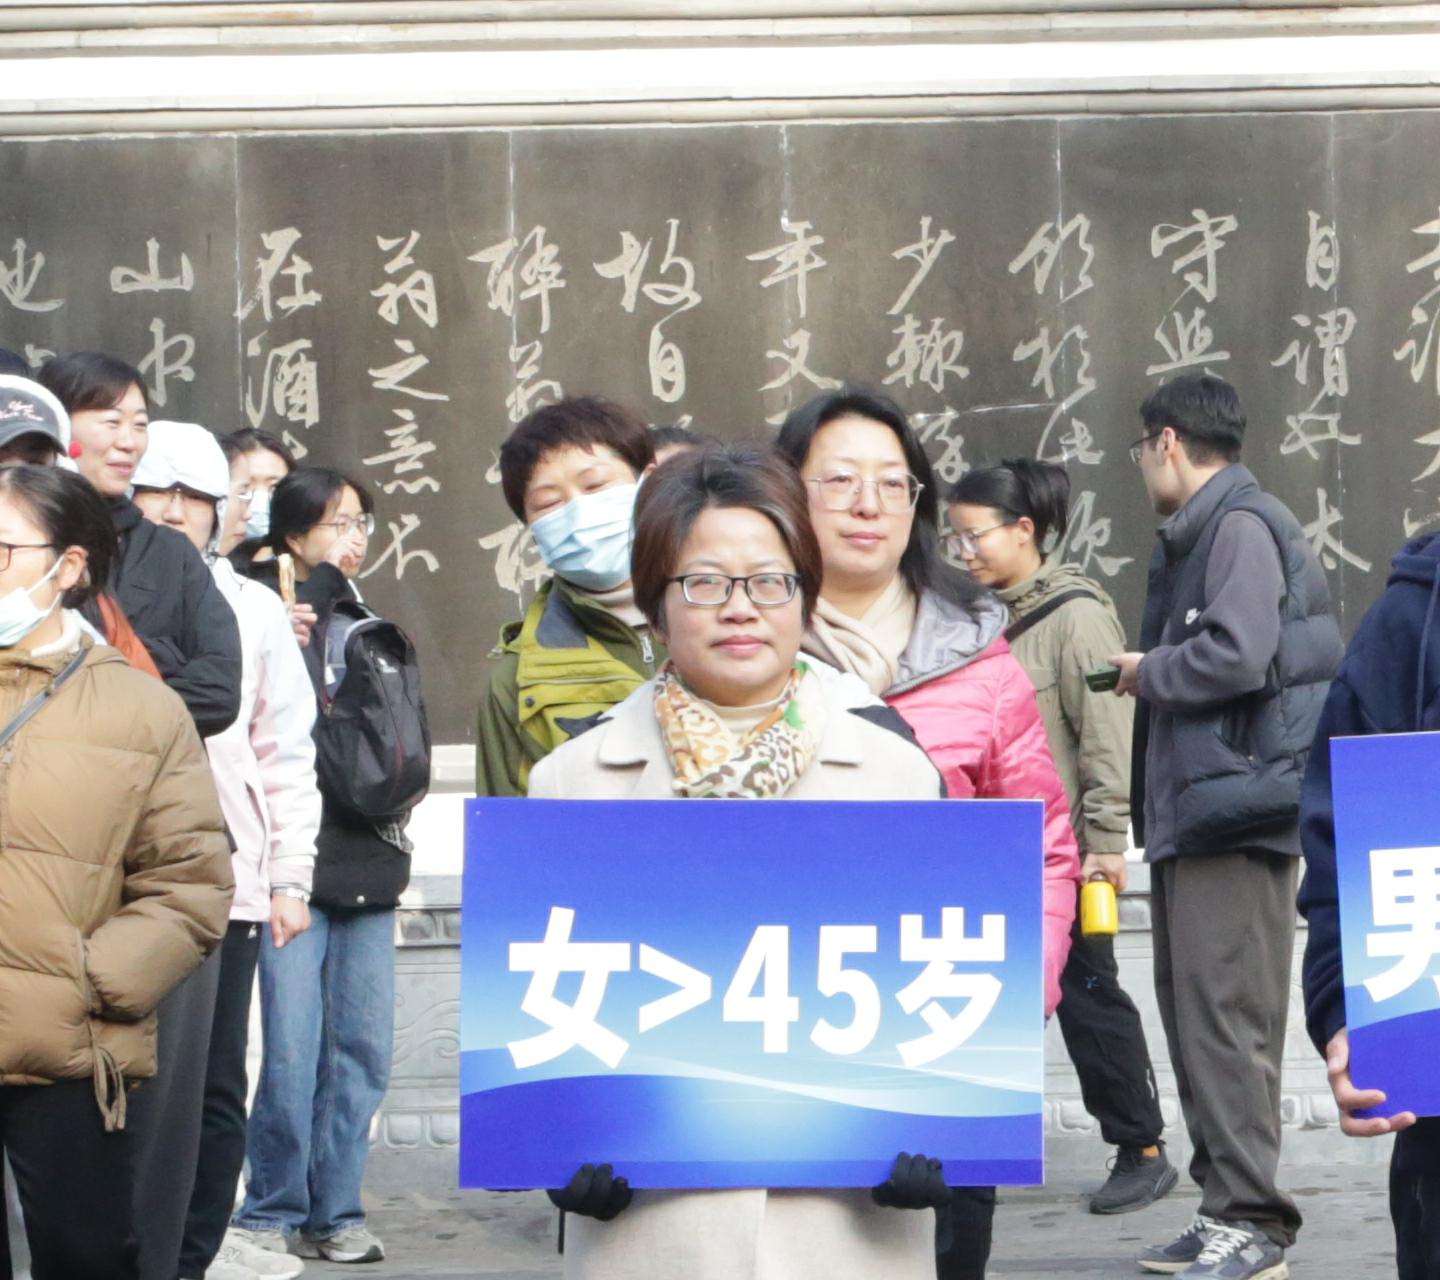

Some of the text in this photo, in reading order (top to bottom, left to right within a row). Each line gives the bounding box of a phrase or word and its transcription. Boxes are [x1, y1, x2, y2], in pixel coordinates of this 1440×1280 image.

[245, 227, 323, 460] 在酒
[593, 219, 703, 428] 故自
[746, 220, 844, 425] 年又
[506, 906, 1006, 1070] 女>45岁
